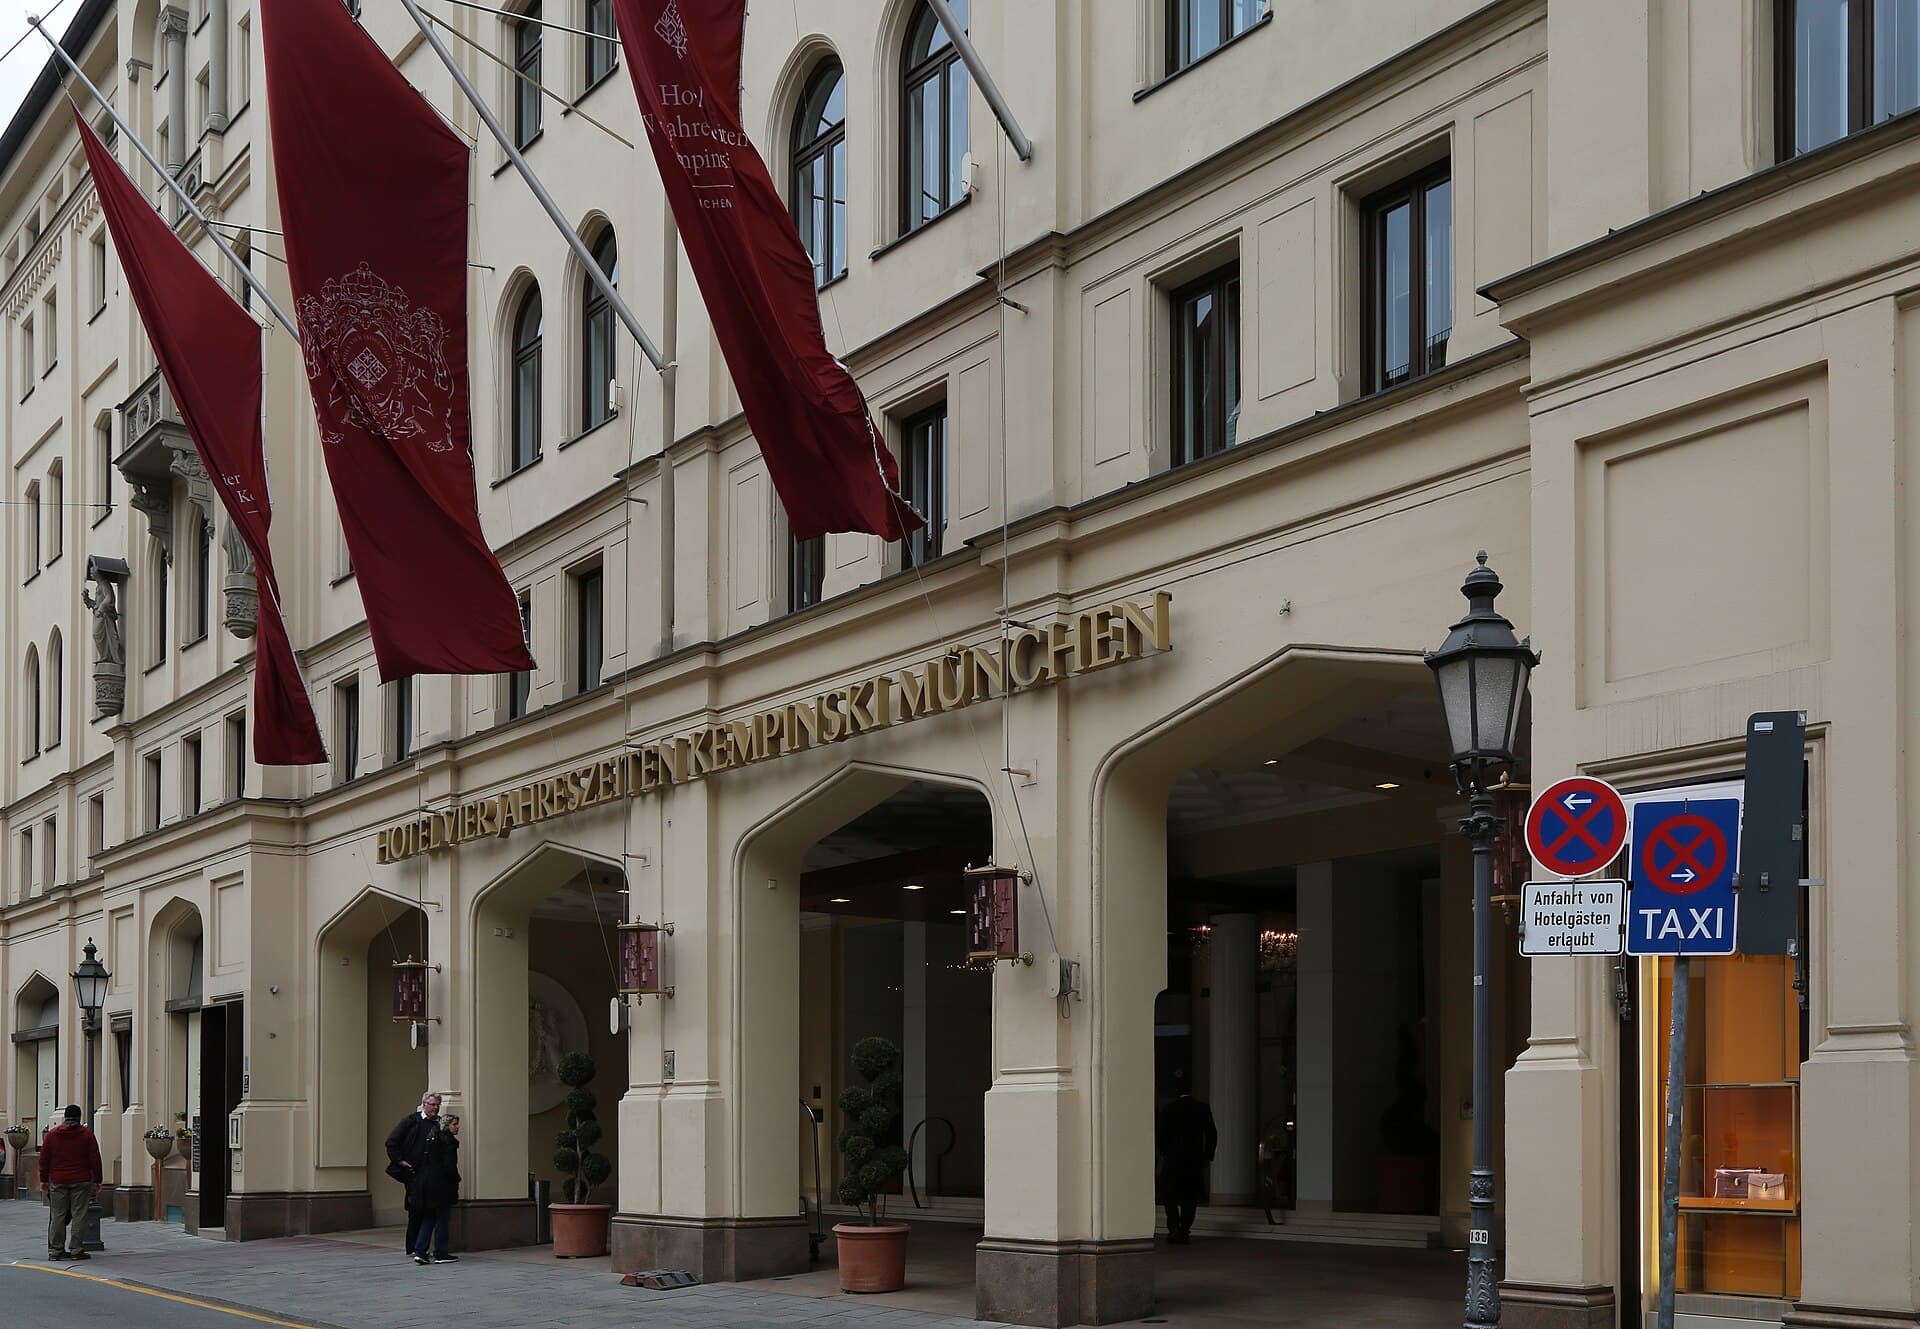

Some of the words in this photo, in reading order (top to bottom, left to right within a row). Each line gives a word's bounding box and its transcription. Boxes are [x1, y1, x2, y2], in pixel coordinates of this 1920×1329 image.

[376, 812, 442, 865] HOTEL
[442, 798, 498, 845] VIER
[494, 736, 689, 839] JAHRESZEITEN
[688, 675, 892, 776] KEMPINSKI
[897, 590, 1173, 722] MÜNCHEN
[1534, 890, 1583, 906] Anfahrt
[1590, 892, 1613, 904] von
[1534, 911, 1611, 929] Hotelgästen
[1638, 907, 1724, 940] TAXI
[1548, 932, 1595, 947] erlaubt
[1470, 1231, 1487, 1243] 139
